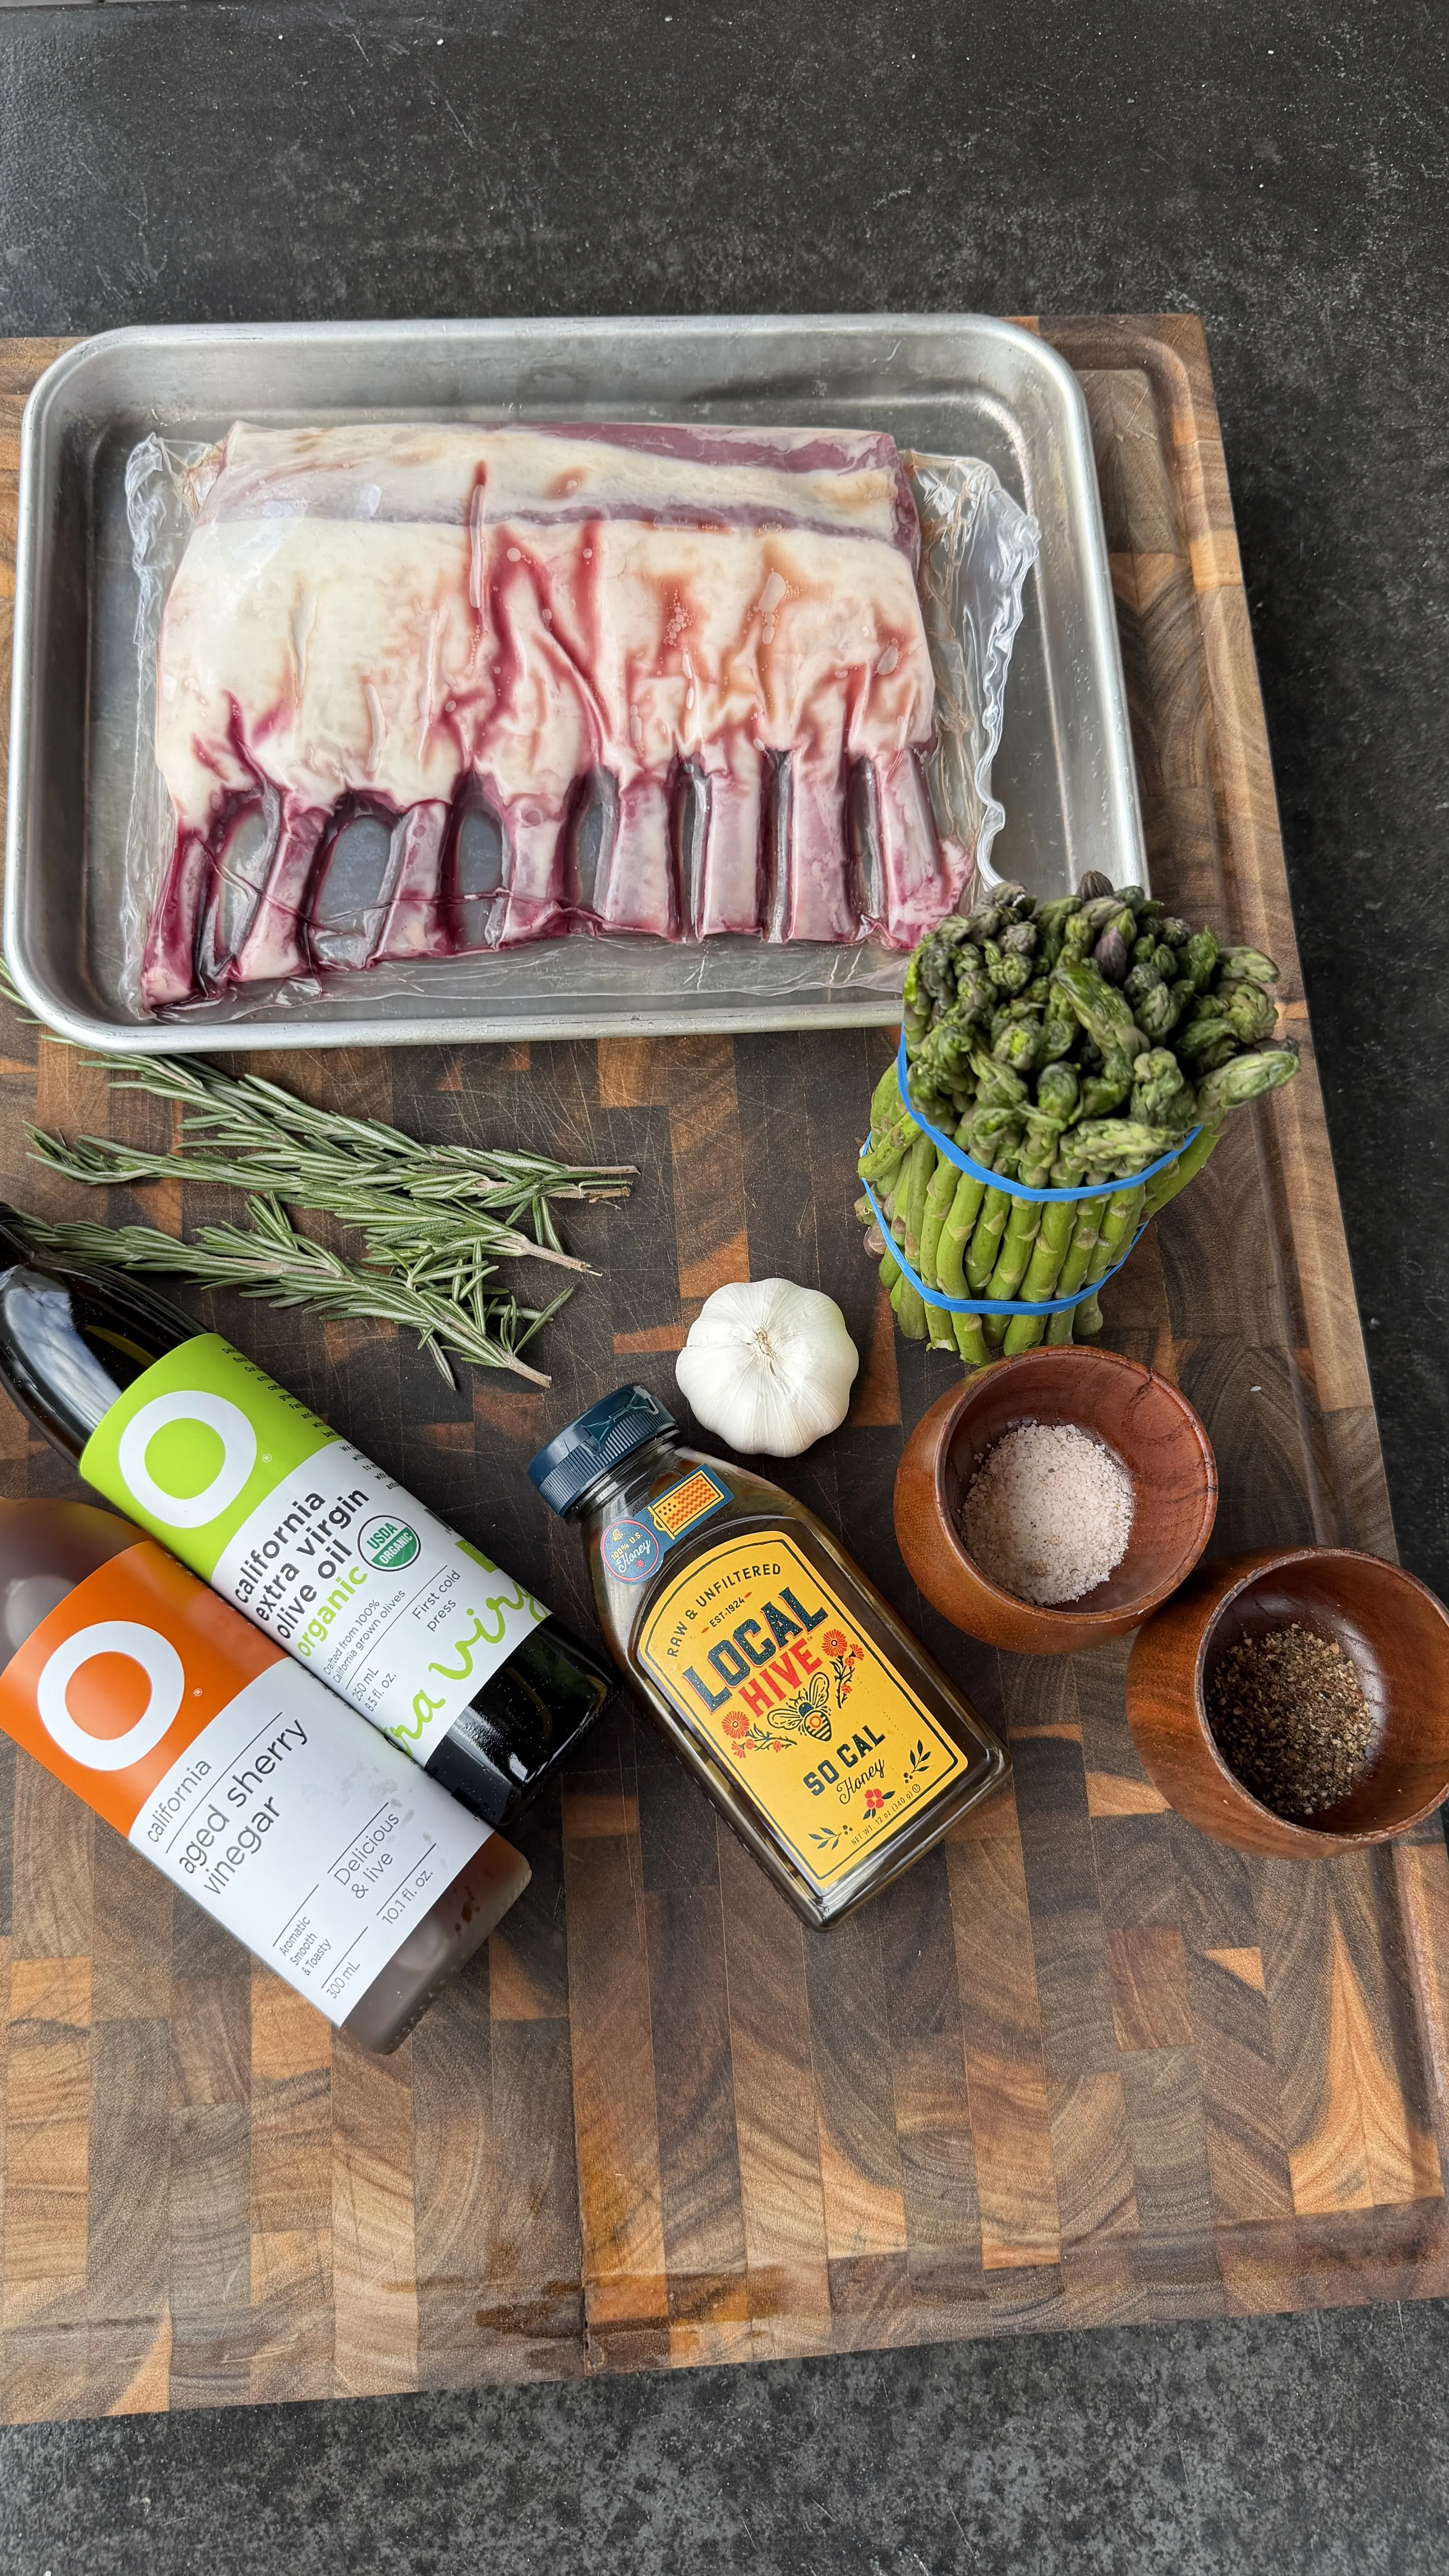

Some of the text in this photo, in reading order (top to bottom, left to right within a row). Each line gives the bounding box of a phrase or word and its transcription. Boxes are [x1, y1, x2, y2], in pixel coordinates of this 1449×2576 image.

[119, 1390, 257, 1528] O
[235, 1493, 326, 1603] california
[257, 1490, 370, 1621] extra virgin
[366, 1523, 397, 1550] USDA
[379, 1532, 413, 1565] ORGANIC
[611, 1532, 643, 1560] 100% U.S.
[616, 1540, 651, 1573] Honey
[277, 1539, 353, 1639] olive oil
[298, 1566, 368, 1657] organic
[413, 1570, 461, 1620] First cold
[427, 1599, 456, 1632] press
[666, 1564, 781, 1658] RAW & UNFILTERED
[323, 1647, 342, 1674] Crafted
[339, 1626, 359, 1651] from
[355, 1600, 380, 1629] 100%
[333, 1590, 405, 1684] California grown olives
[682, 1587, 828, 1715] LOCAL
[37, 1620, 184, 1771] O
[352, 1668, 379, 1702] 250 mL
[365, 1673, 397, 1712] 8.5 fl. oz.
[738, 1638, 823, 1717] HIVE
[803, 1725, 885, 1796] SO CAL
[836, 1759, 884, 1804] Honey
[147, 1760, 212, 1843] california
[179, 1719, 308, 1874] aged sherry
[851, 1834, 862, 1845] NET
[863, 1825, 875, 1835] WT.
[875, 1817, 883, 1825] 12
[892, 1798, 905, 1812] (340
[906, 1791, 913, 1799] g)
[204, 1795, 281, 1895] vinegar
[334, 1813, 399, 1885] Delicious
[351, 1853, 393, 1899] & live
[382, 1869, 433, 1925] 10.1 fl. oz.
[279, 1916, 310, 1956] Aromatic
[290, 1932, 318, 1966] Smooth
[301, 1938, 332, 1976] & Toasty
[326, 1962, 360, 1999] 300 mL
